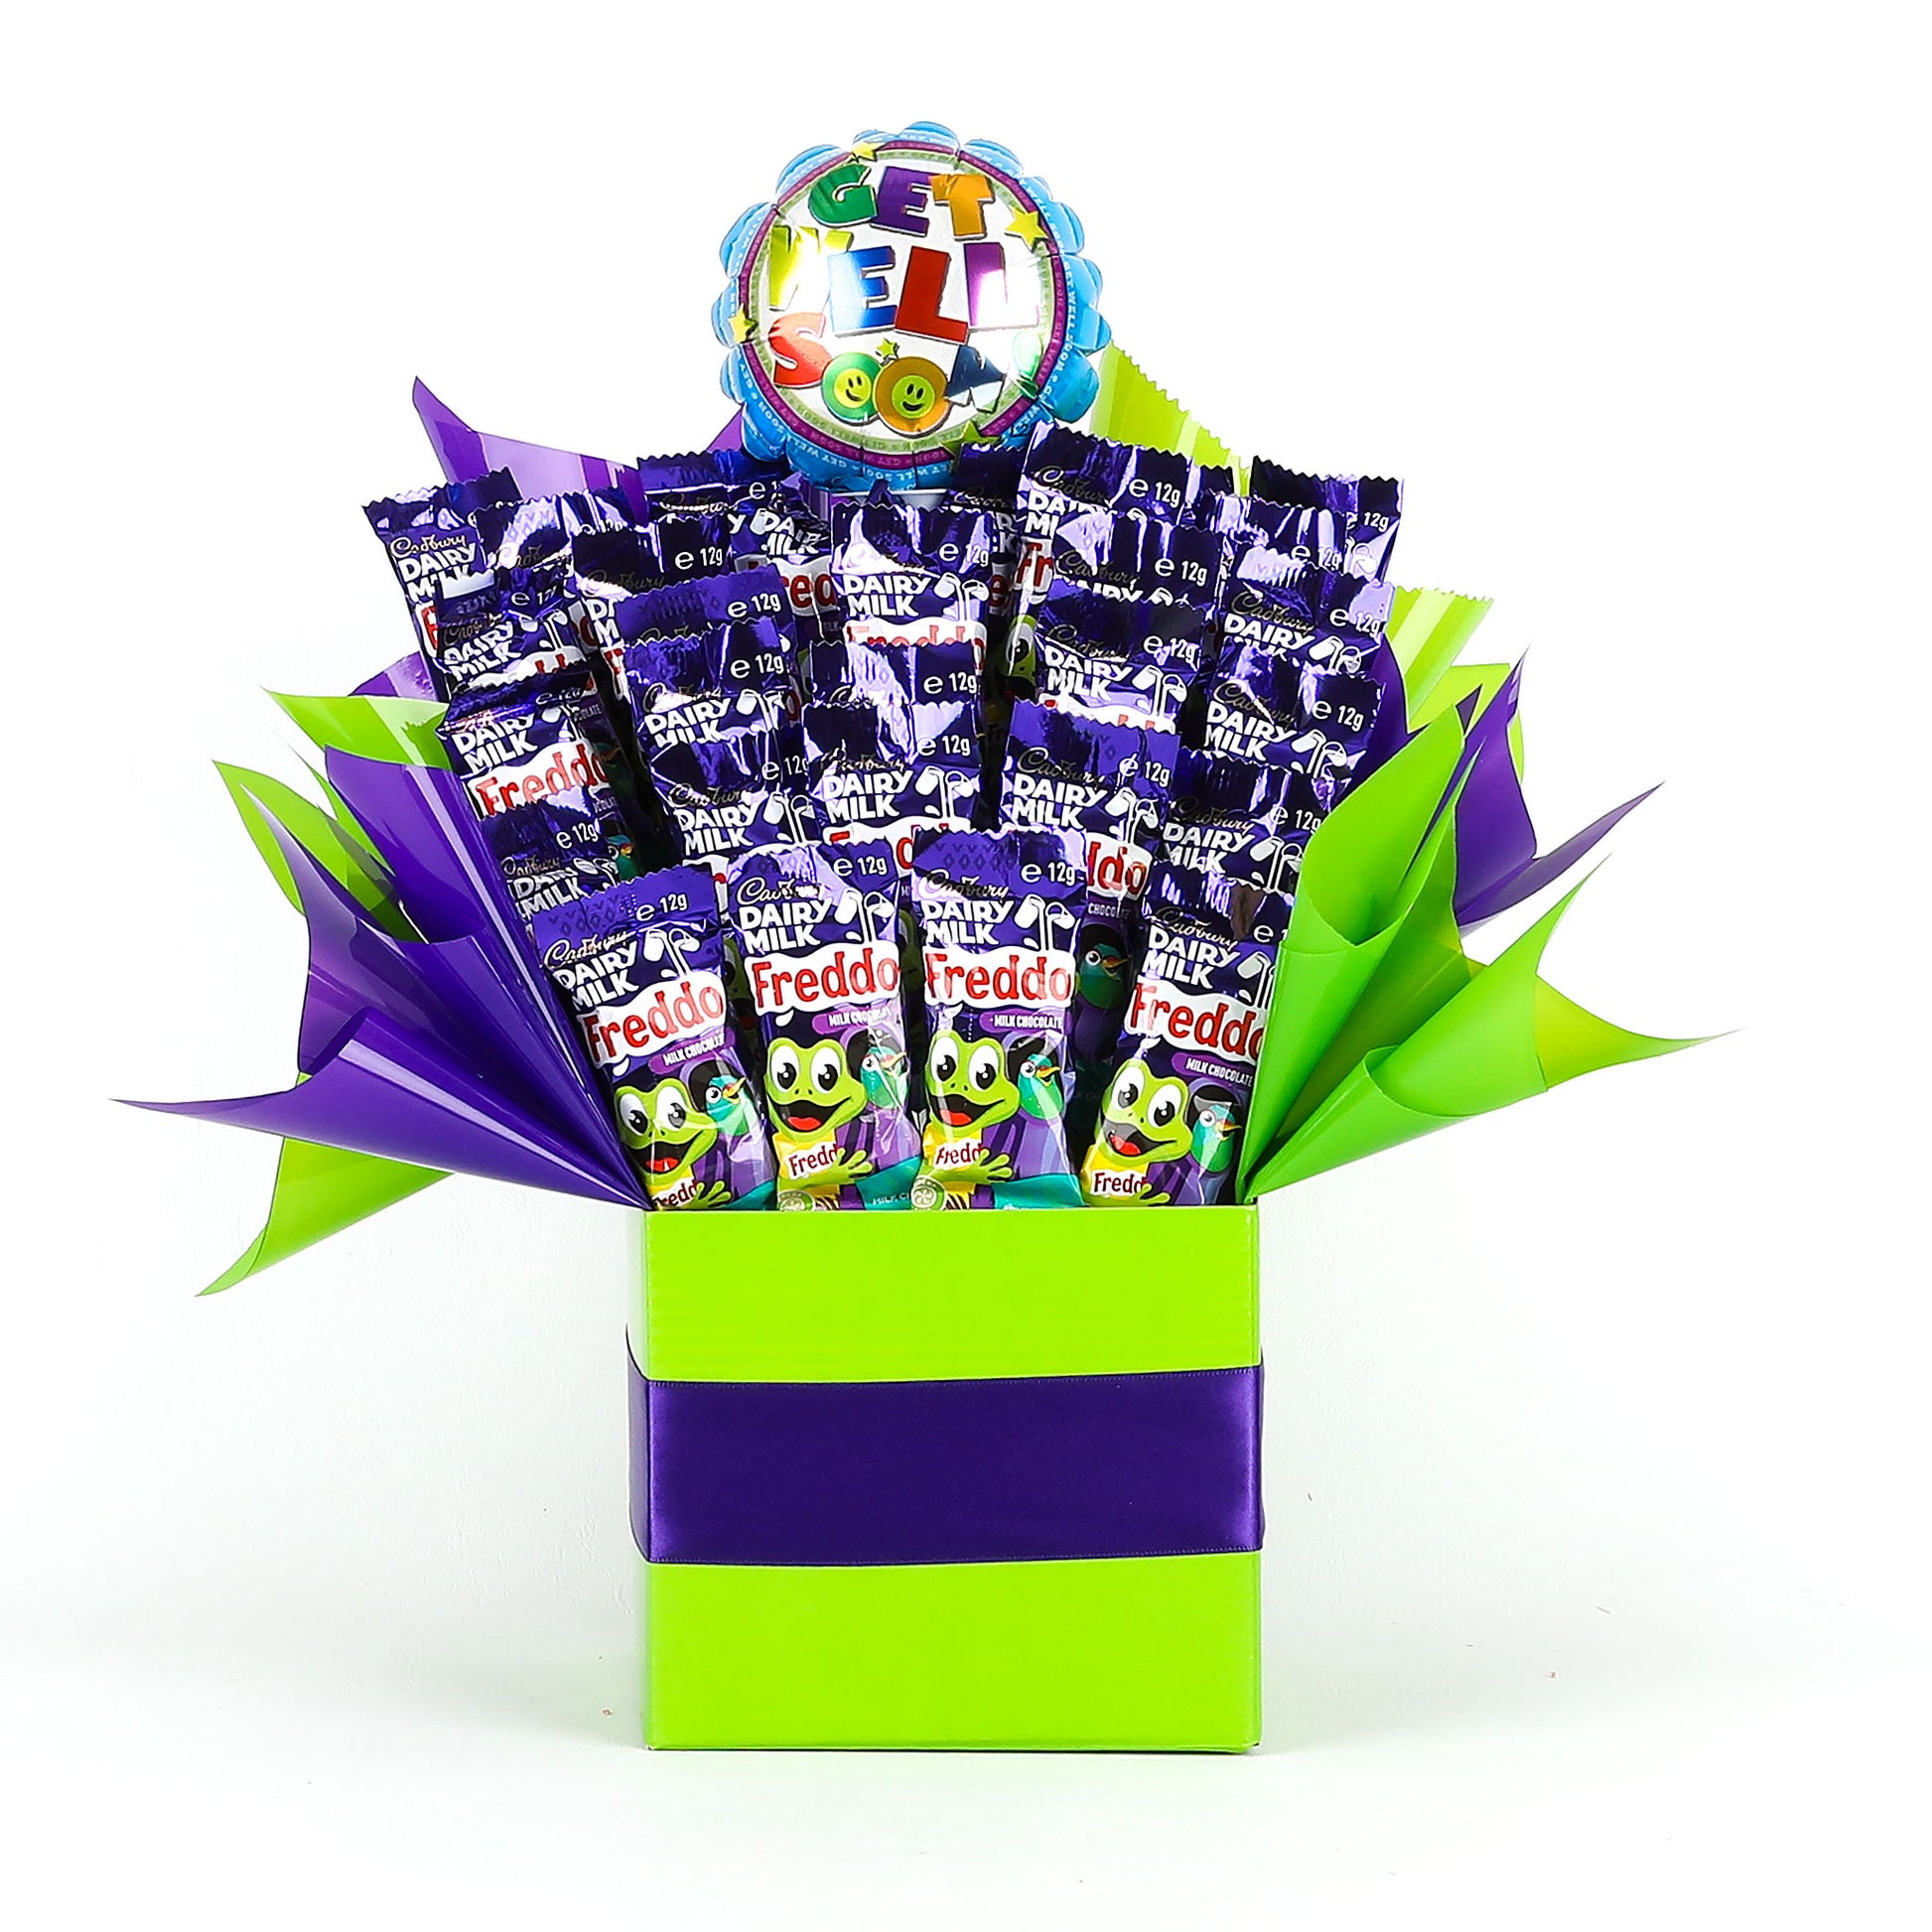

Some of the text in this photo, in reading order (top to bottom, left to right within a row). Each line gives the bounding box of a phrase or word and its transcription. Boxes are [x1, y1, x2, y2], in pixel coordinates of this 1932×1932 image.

[809, 164, 994, 240] GET
[768, 224, 1039, 345] WELL
[1155, 482, 1180, 508] 12g
[1363, 512, 1389, 533] 12g
[390, 534, 468, 558] Cadbury
[700, 547, 723, 566] 12g
[965, 544, 989, 568] 12g
[398, 543, 476, 583] DAIRY
[1181, 560, 1208, 586] 12g
[844, 575, 931, 595] DAIRY
[751, 593, 781, 613] 12g
[847, 594, 919, 617] MILK
[1224, 613, 1315, 651] DAIRY
[1354, 612, 1381, 638] 12g
[444, 621, 514, 665] DAIRY
[1169, 636, 1198, 664] 12g
[448, 640, 522, 682] MILK
[756, 652, 785, 675] 12g
[1043, 645, 1134, 682] DAIRY
[949, 671, 978, 694] 12g
[1047, 667, 1113, 702] MILK
[643, 697, 732, 735] DAIRY
[1207, 701, 1298, 744] DAIRY
[1337, 705, 1365, 733] 12g
[452, 713, 536, 756] DAIRY
[941, 735, 971, 756] 12g
[1204, 724, 1270, 761] MILK
[464, 729, 538, 774] MILK
[822, 768, 913, 803] DAIRY
[1013, 772, 1108, 808] DAIRY
[1145, 760, 1171, 788] 12g
[672, 798, 761, 832] DAIRY
[825, 794, 900, 823] MILK
[1013, 796, 1084, 829] MILK
[572, 822, 599, 844] 12g
[684, 827, 754, 856] MILK
[1163, 821, 1255, 853] DAIRY
[857, 856, 888, 876] 12g
[1166, 842, 1228, 874] MILK
[1047, 862, 1076, 888] 12g
[518, 876, 589, 917] MILK
[659, 894, 688, 914] 12g
[920, 899, 1015, 924] DAIRY
[739, 897, 833, 930] DAIRY
[745, 923, 821, 954] MILK
[925, 919, 1000, 945] MILK
[1148, 924, 1241, 969] DAIRY
[544, 931, 638, 969] Cadbury
[552, 939, 638, 991] DAIRY
[752, 947, 901, 1009] Freddo
[924, 953, 1072, 1001] Freddo
[1143, 949, 1215, 989] MILK
[571, 968, 640, 1012] MILK
[583, 980, 724, 1064] Freddo
[828, 1011, 852, 1028] MILK
[994, 1014, 1065, 1030] MILK CHOCOLATE
[1130, 982, 1266, 1061] Freddo
[662, 1045, 687, 1067] MILK
[1185, 1056, 1254, 1088] MILK CHOCOLATE
[787, 1143, 841, 1176] Fredd
[935, 1143, 985, 1166] Fredd
